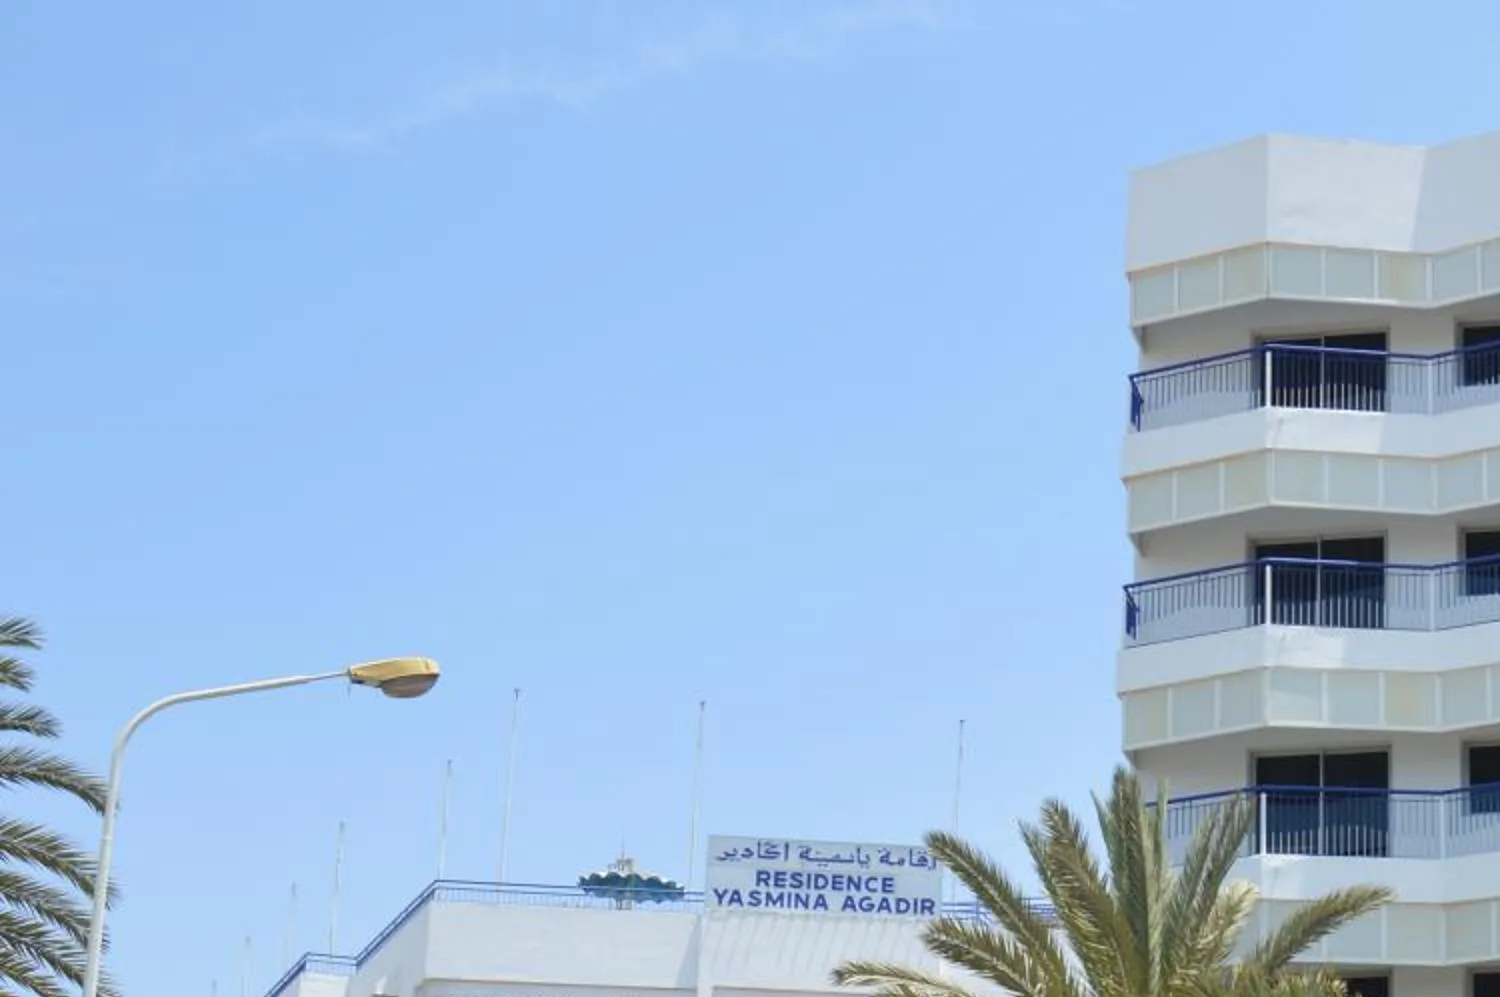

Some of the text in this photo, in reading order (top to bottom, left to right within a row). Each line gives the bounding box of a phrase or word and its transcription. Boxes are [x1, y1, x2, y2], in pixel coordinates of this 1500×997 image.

[756, 870, 895, 893] RESIDENCE
[713, 888, 936, 915] YASMINA AGADIR
